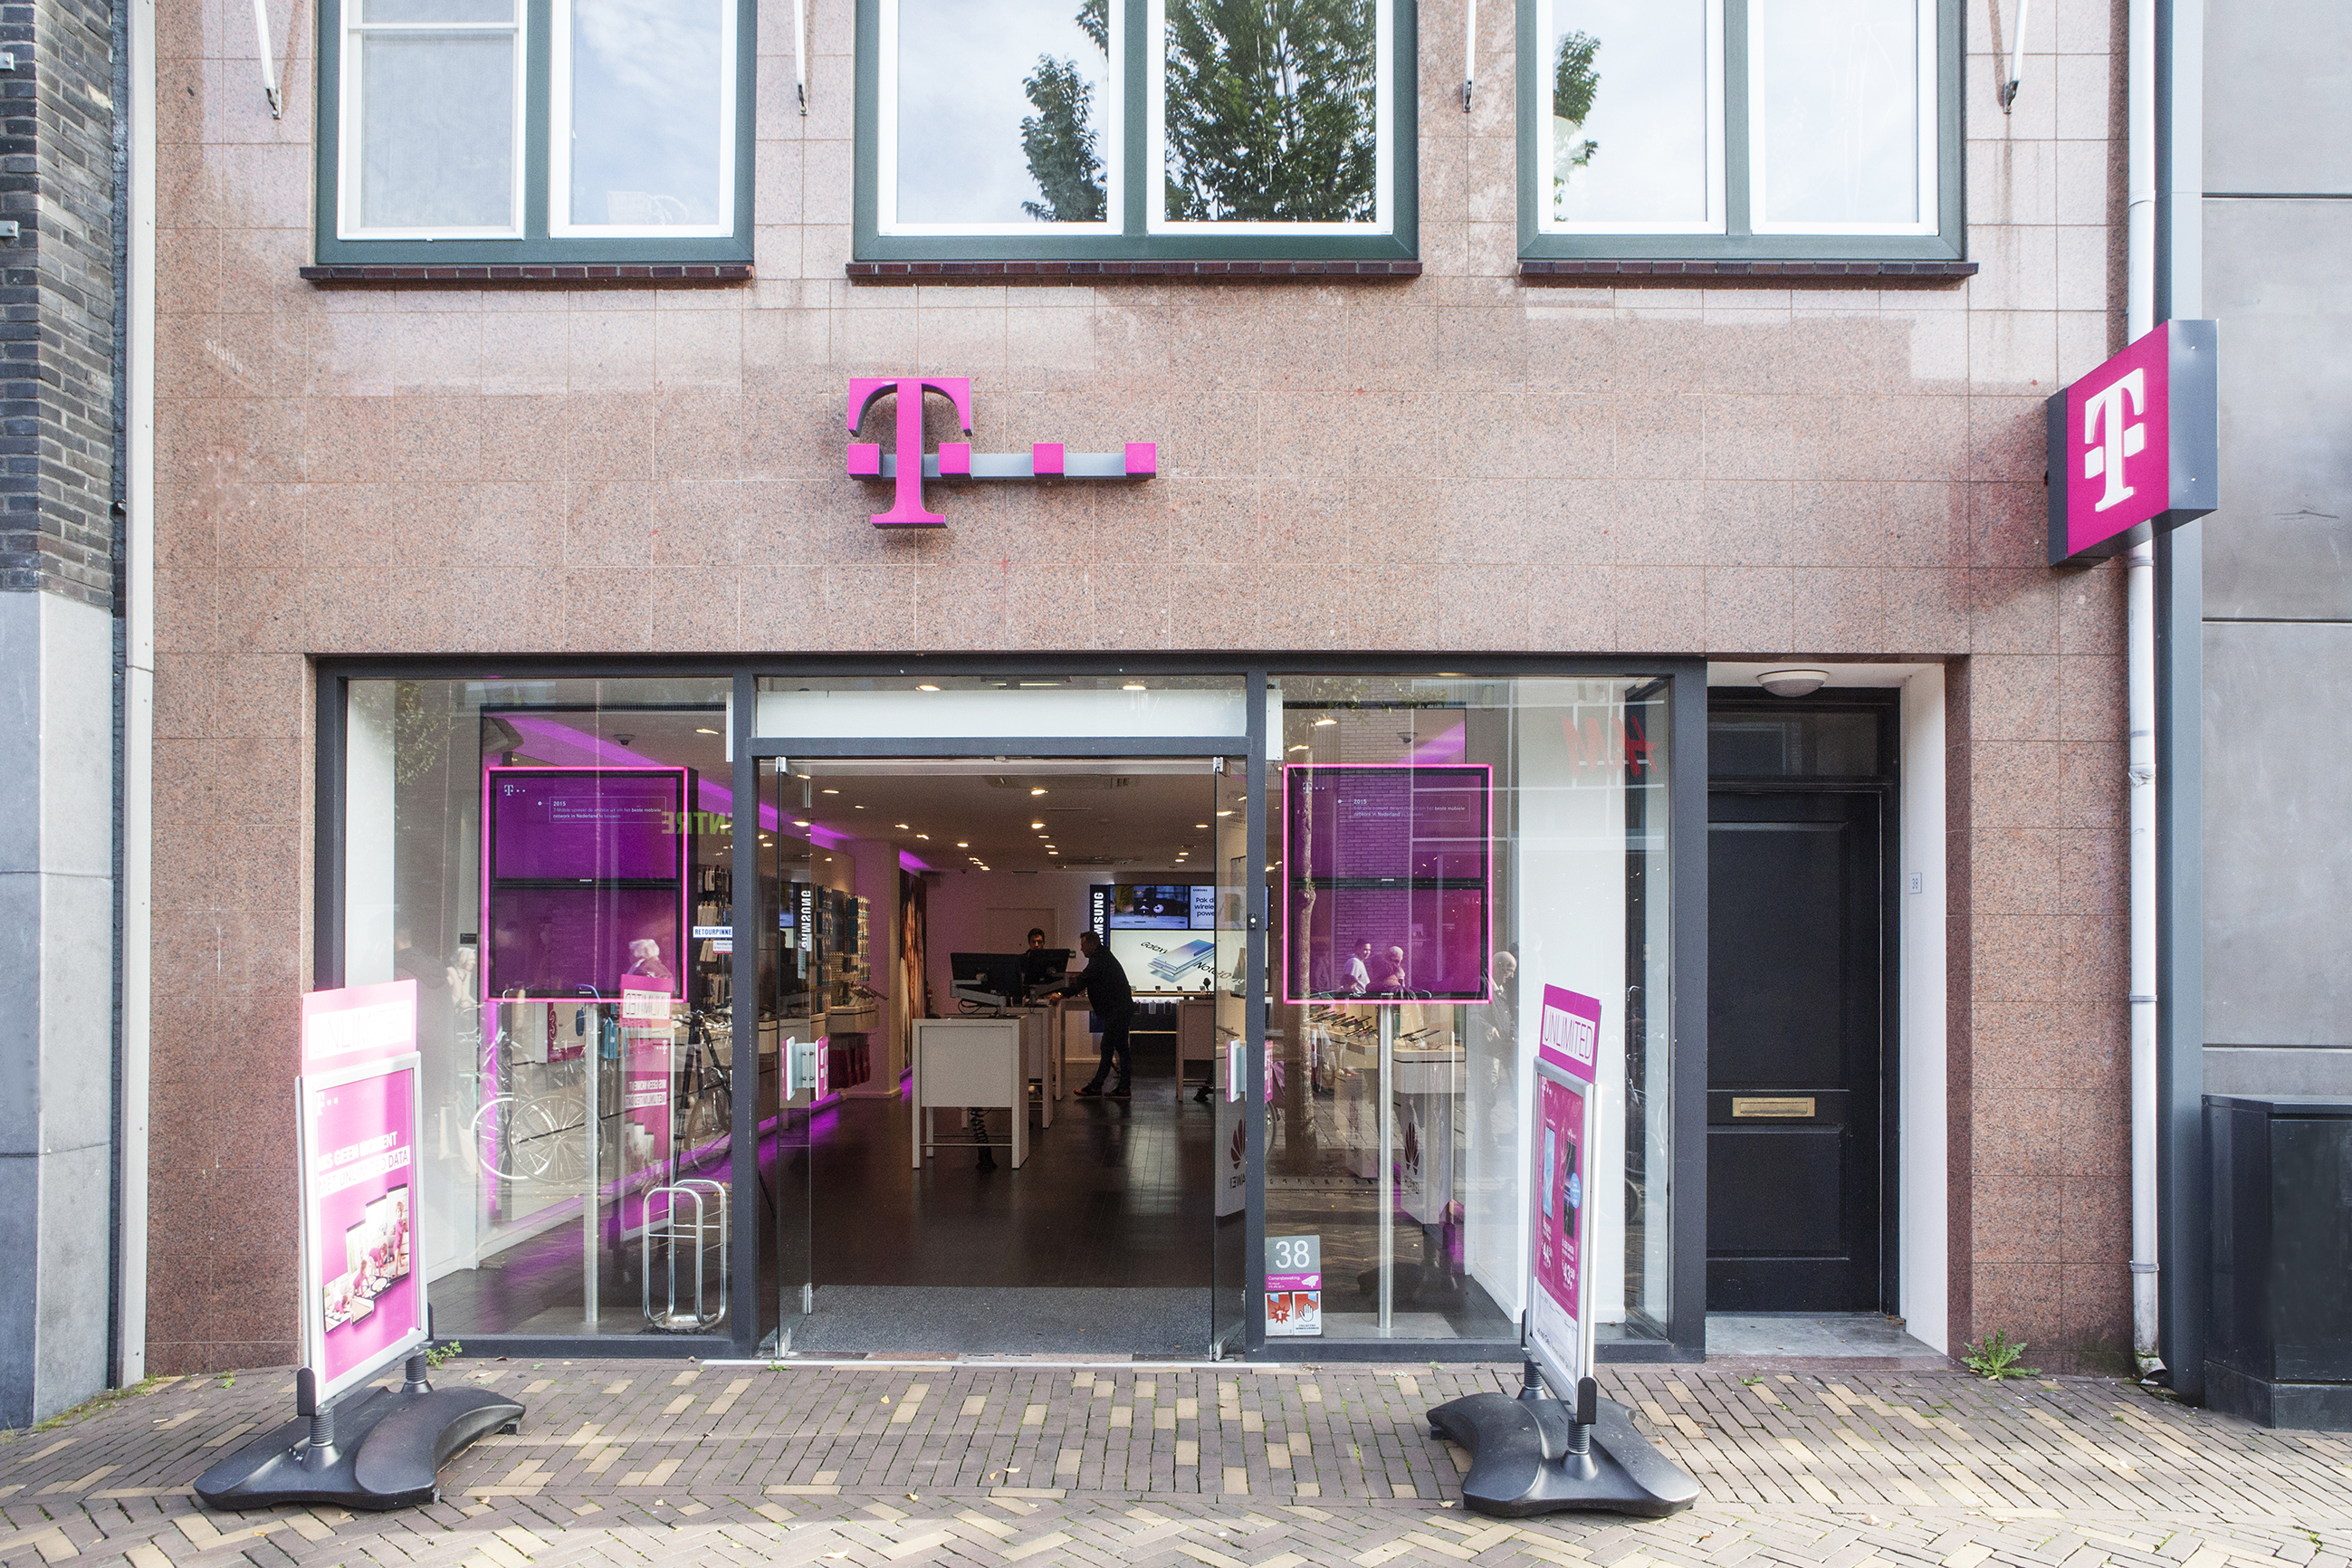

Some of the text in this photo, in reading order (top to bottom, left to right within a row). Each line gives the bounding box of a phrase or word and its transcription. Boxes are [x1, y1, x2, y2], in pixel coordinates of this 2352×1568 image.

[1094, 892, 1104, 946] MSUNG
[312, 1006, 407, 1054] UNLIMTED
[1544, 1010, 1593, 1059] UNLIMITED
[334, 1144, 359, 1166] GEEN
[360, 1131, 397, 1157] MOMENT
[388, 1150, 409, 1168] DATA
[1276, 1240, 1310, 1268] 38
